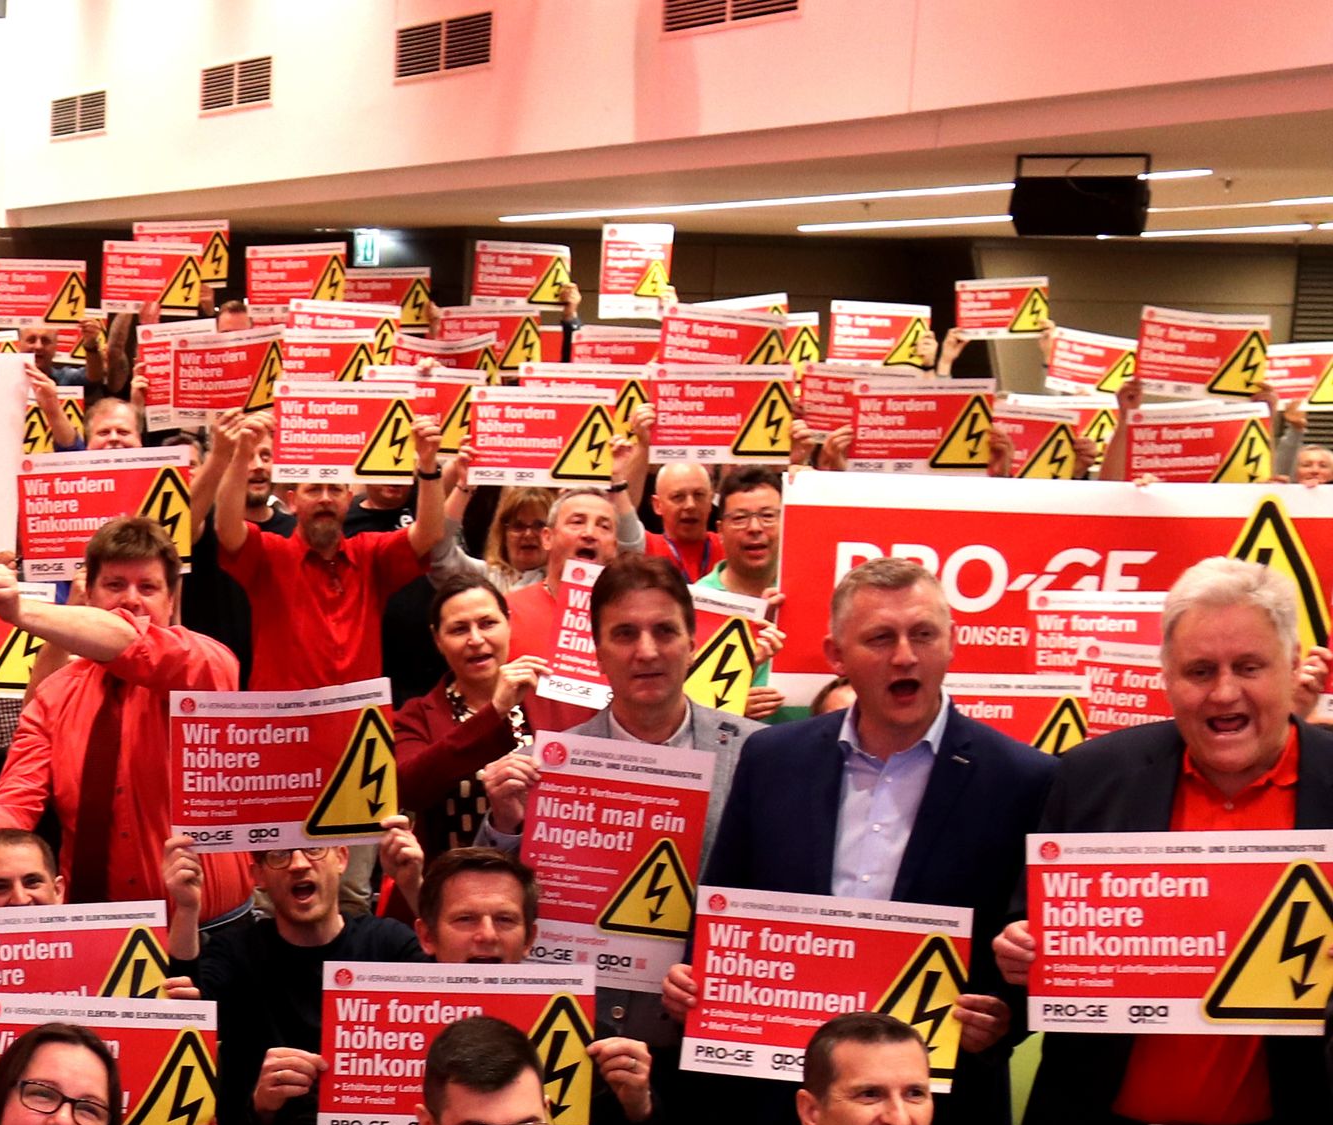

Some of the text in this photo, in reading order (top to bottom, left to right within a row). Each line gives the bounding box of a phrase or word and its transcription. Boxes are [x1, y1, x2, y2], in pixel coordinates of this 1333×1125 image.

[657, 383, 735, 397] Wir fordern
[280, 401, 358, 415] Wir fordern
[657, 398, 705, 412] höhere
[280, 415, 328, 430] höhere
[657, 412, 741, 427] Einkommen!
[280, 430, 365, 445] Einkommen!
[24, 477, 115, 496] Wir fordern
[26, 498, 78, 514] höhere
[182, 723, 310, 745] Wir fordern
[182, 746, 260, 769] höhere
[182, 768, 323, 792] Einkommen!
[536, 796, 686, 833] Nicht mal ein
[532, 822, 634, 852] Angebot!
[1042, 870, 1209, 899] Wir fordern
[1042, 900, 1144, 929] höhere
[708, 922, 856, 960] Wir fordern
[1042, 928, 1227, 958] Einkommen!
[597, 953, 631, 971] gpa
[705, 951, 796, 982] höhere
[703, 976, 867, 1014] Einkommen!
[1043, 1003, 1169, 1024] PRO-GE gpa
[695, 1045, 754, 1063] PRO-GE
